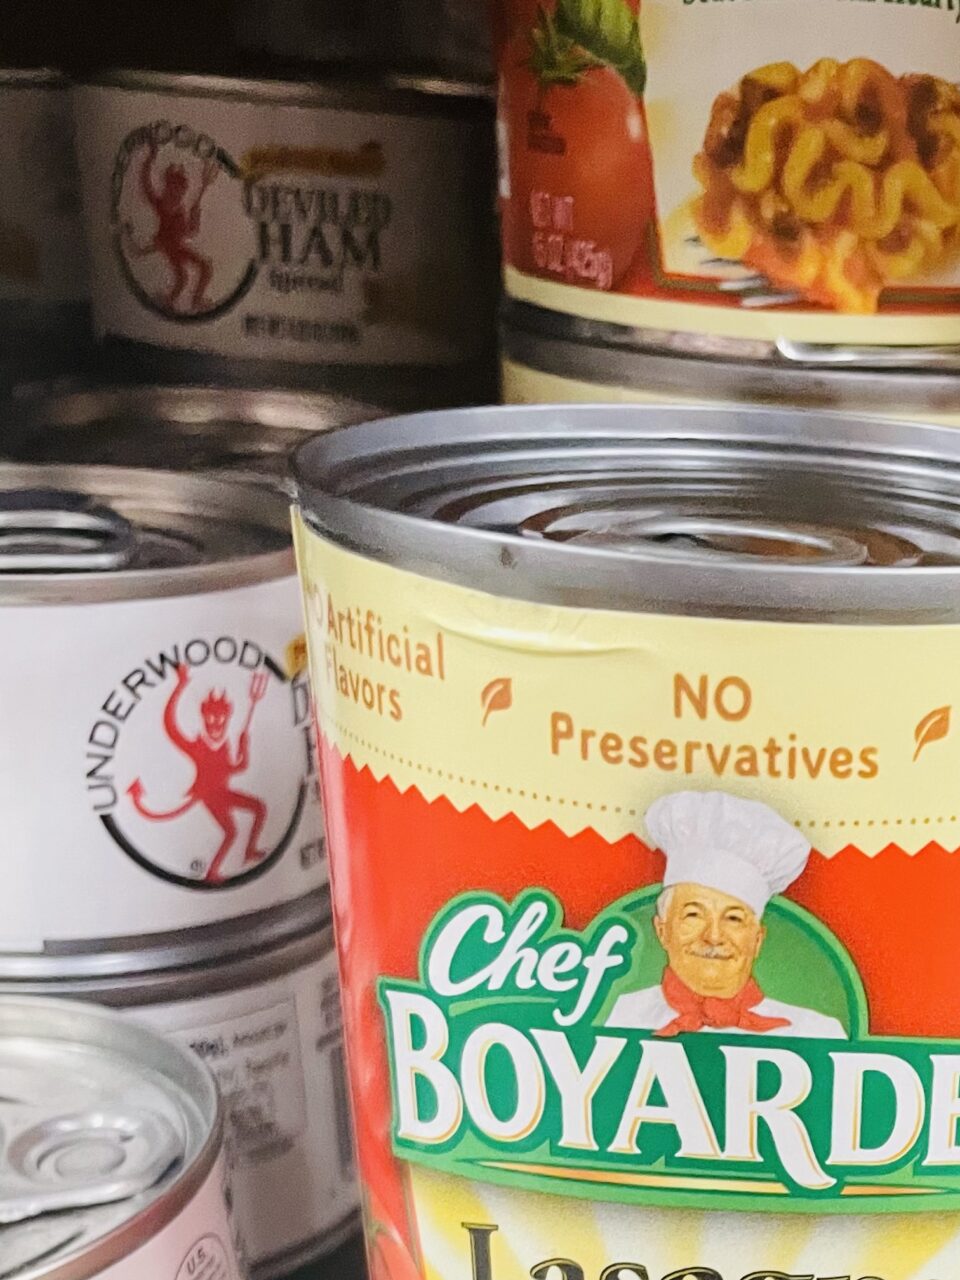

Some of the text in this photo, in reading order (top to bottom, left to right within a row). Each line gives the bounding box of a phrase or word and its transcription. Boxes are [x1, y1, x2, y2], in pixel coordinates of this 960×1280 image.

[258, 221, 382, 271] HAM
[327, 592, 446, 681] Artificial
[86, 635, 265, 814] UNDERWOOD
[672, 672, 753, 722] NO
[550, 711, 880, 781] Preservatives
[427, 899, 630, 1027] Chef
